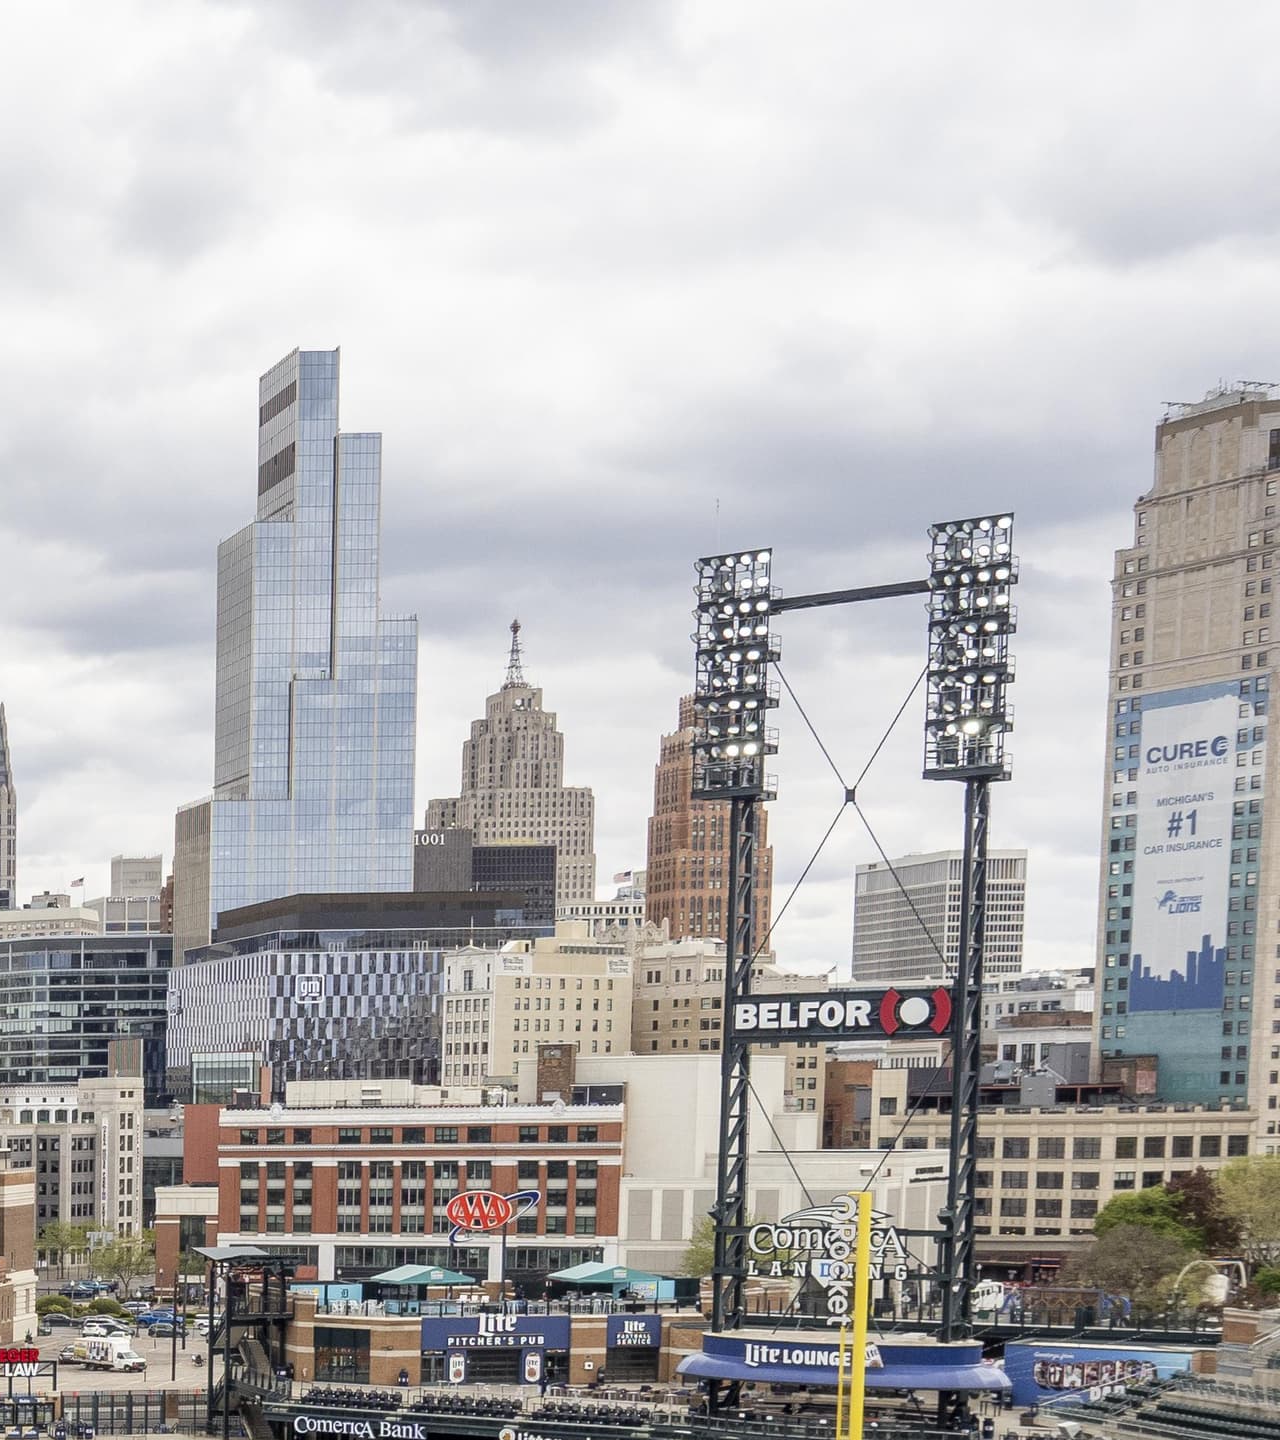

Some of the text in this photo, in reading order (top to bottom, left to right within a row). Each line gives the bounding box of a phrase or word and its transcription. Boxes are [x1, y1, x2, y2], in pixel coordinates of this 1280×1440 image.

[1146, 740, 1208, 764] CURE
[1146, 757, 1229, 775] AUTO INSURANCE
[1157, 792, 1214, 807] MICHIGAN'S
[1168, 809, 1197, 838] #1
[415, 833, 446, 846] 1001
[1144, 838, 1223, 855] CAR INSURANCE
[1168, 901, 1202, 914] LIONS
[734, 999, 870, 1031] BELFOR
[452, 1194, 505, 1229] AAA
[826, 1224, 856, 1326] Rocket
[479, 1313, 518, 1336] Lite
[623, 1321, 645, 1333] Lite
[448, 1336, 545, 1346] PITCHER'S PUB
[745, 1344, 851, 1367] Lite LOUNGE
[4, 1363, 39, 1376] LAW
[380, 1421, 427, 1440] Bank
